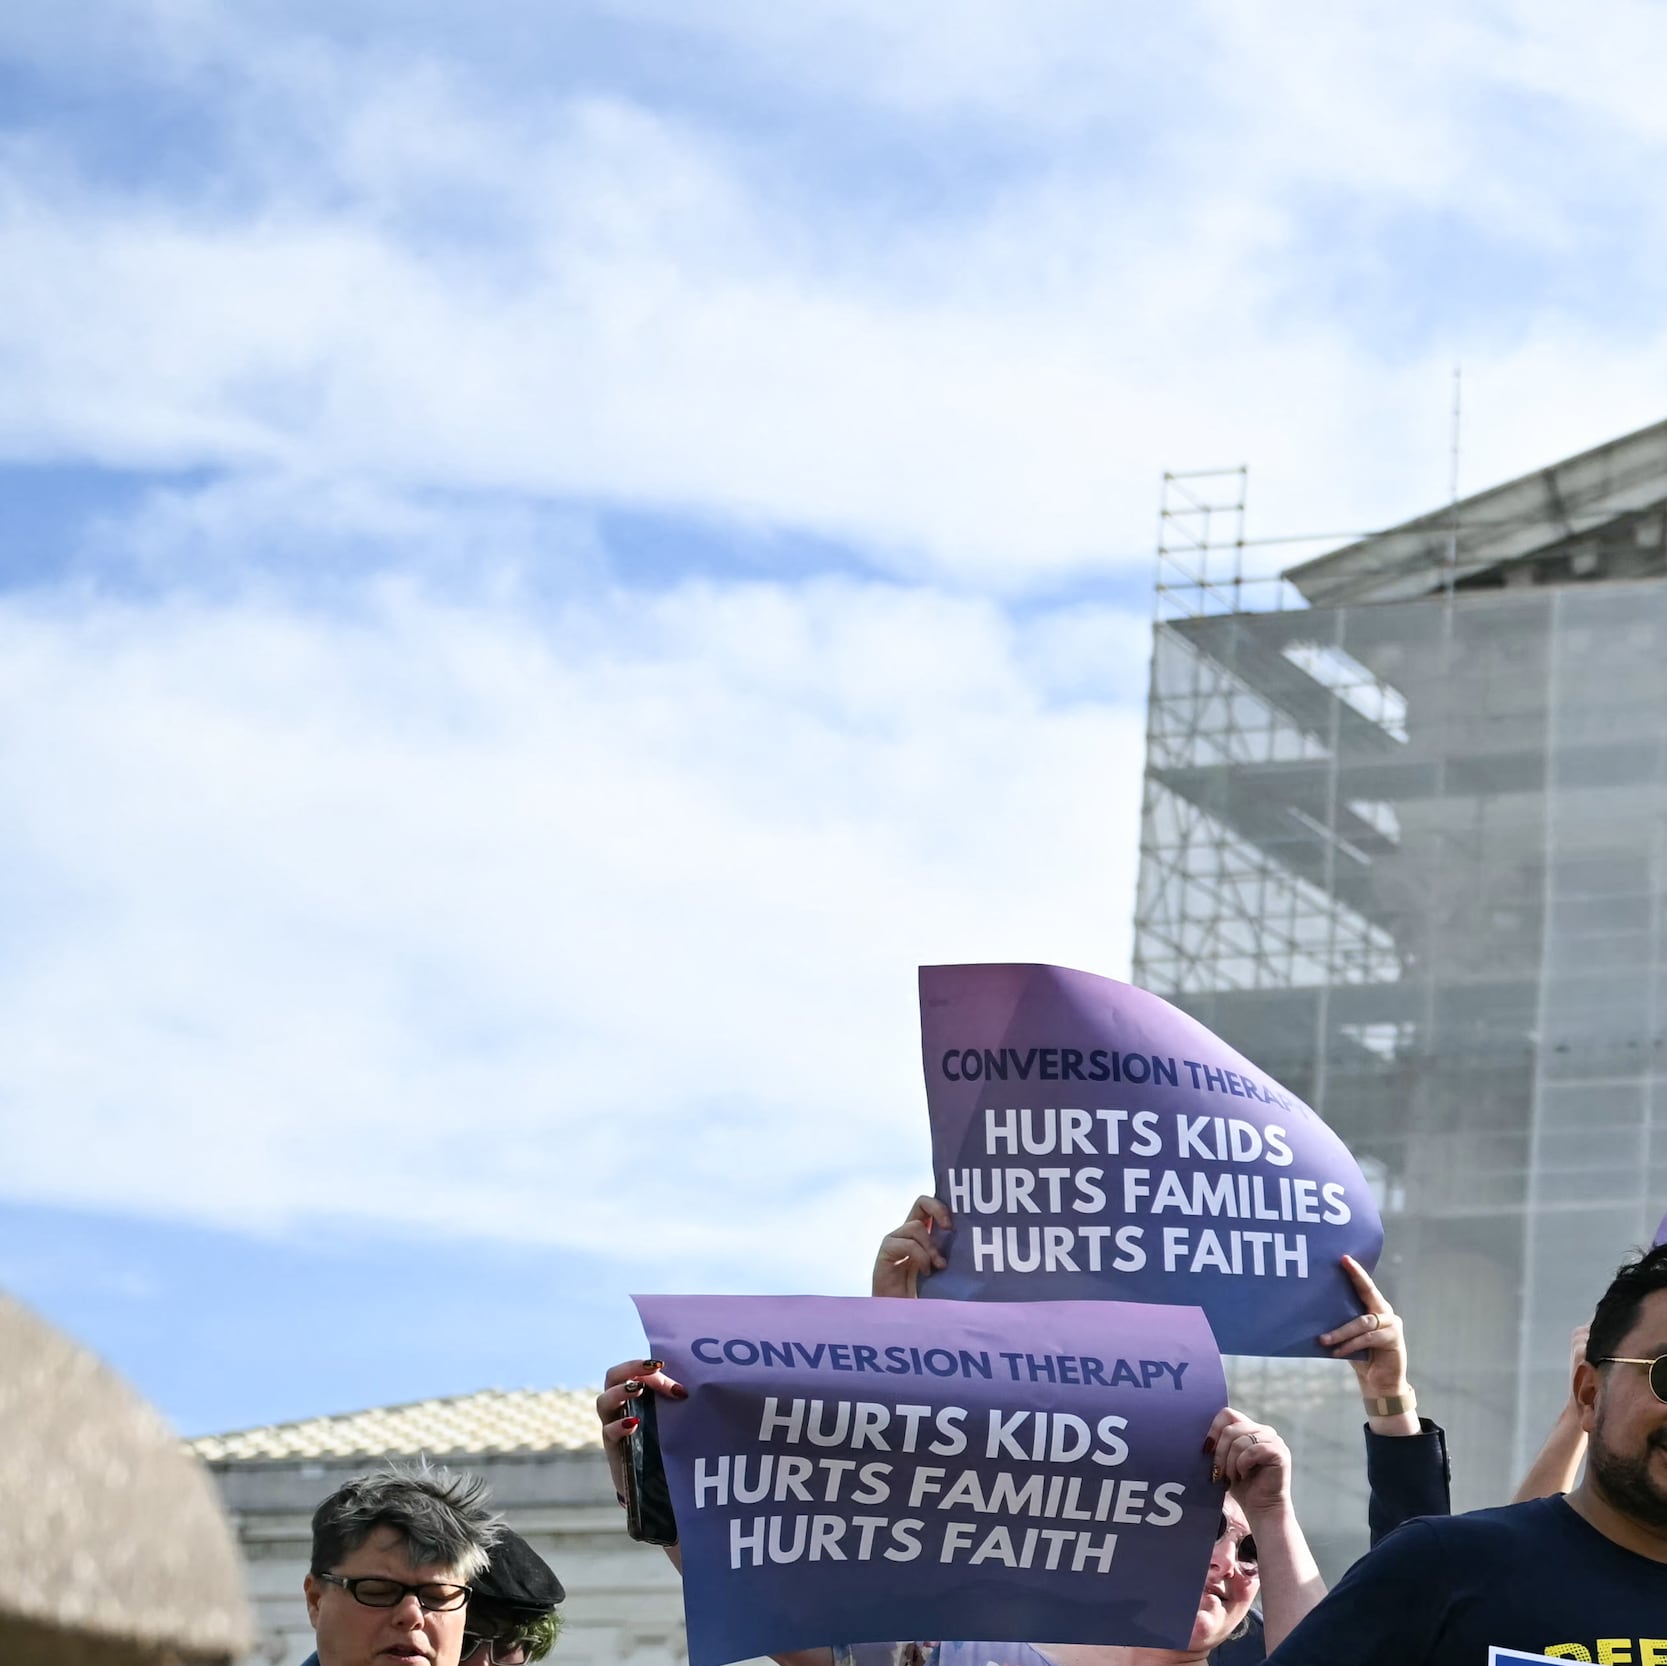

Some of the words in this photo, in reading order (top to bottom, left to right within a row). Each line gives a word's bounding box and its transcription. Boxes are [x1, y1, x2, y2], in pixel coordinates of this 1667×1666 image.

[942, 1048, 1177, 1087] CONVERSION
[985, 1109, 1160, 1158] HURTS
[1178, 1114, 1295, 1168] KIDS
[948, 1168, 1105, 1216] HURTS
[1125, 1169, 1353, 1227] FAMILIES
[973, 1226, 1147, 1273] HURTS
[1164, 1227, 1310, 1280] FAITH
[691, 1338, 994, 1380] CONVERSION
[1000, 1352, 1190, 1391] THERAPY
[759, 1397, 969, 1457] HURTS
[986, 1409, 1131, 1466] KIDS
[694, 1457, 891, 1509] HURTS
[909, 1467, 1187, 1528] FAMILIES
[729, 1515, 924, 1570] HURTS
[940, 1522, 1119, 1575] FAITH
